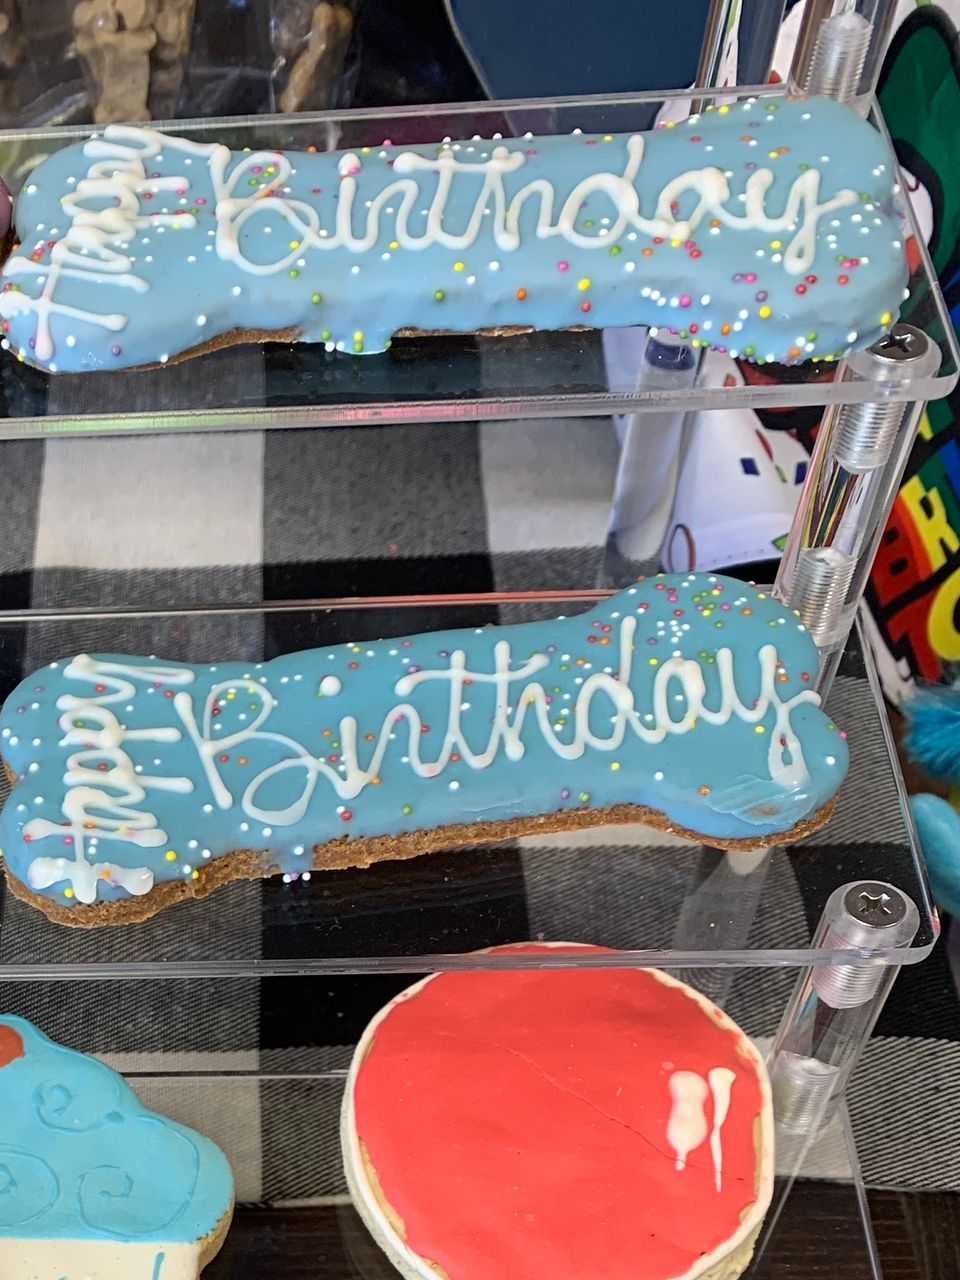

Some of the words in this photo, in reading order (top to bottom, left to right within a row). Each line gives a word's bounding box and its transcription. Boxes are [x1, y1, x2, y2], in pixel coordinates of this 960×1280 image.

[210, 135, 858, 276] Birthday
[22, 654, 197, 904] Happy
[173, 614, 823, 827] Birthday
